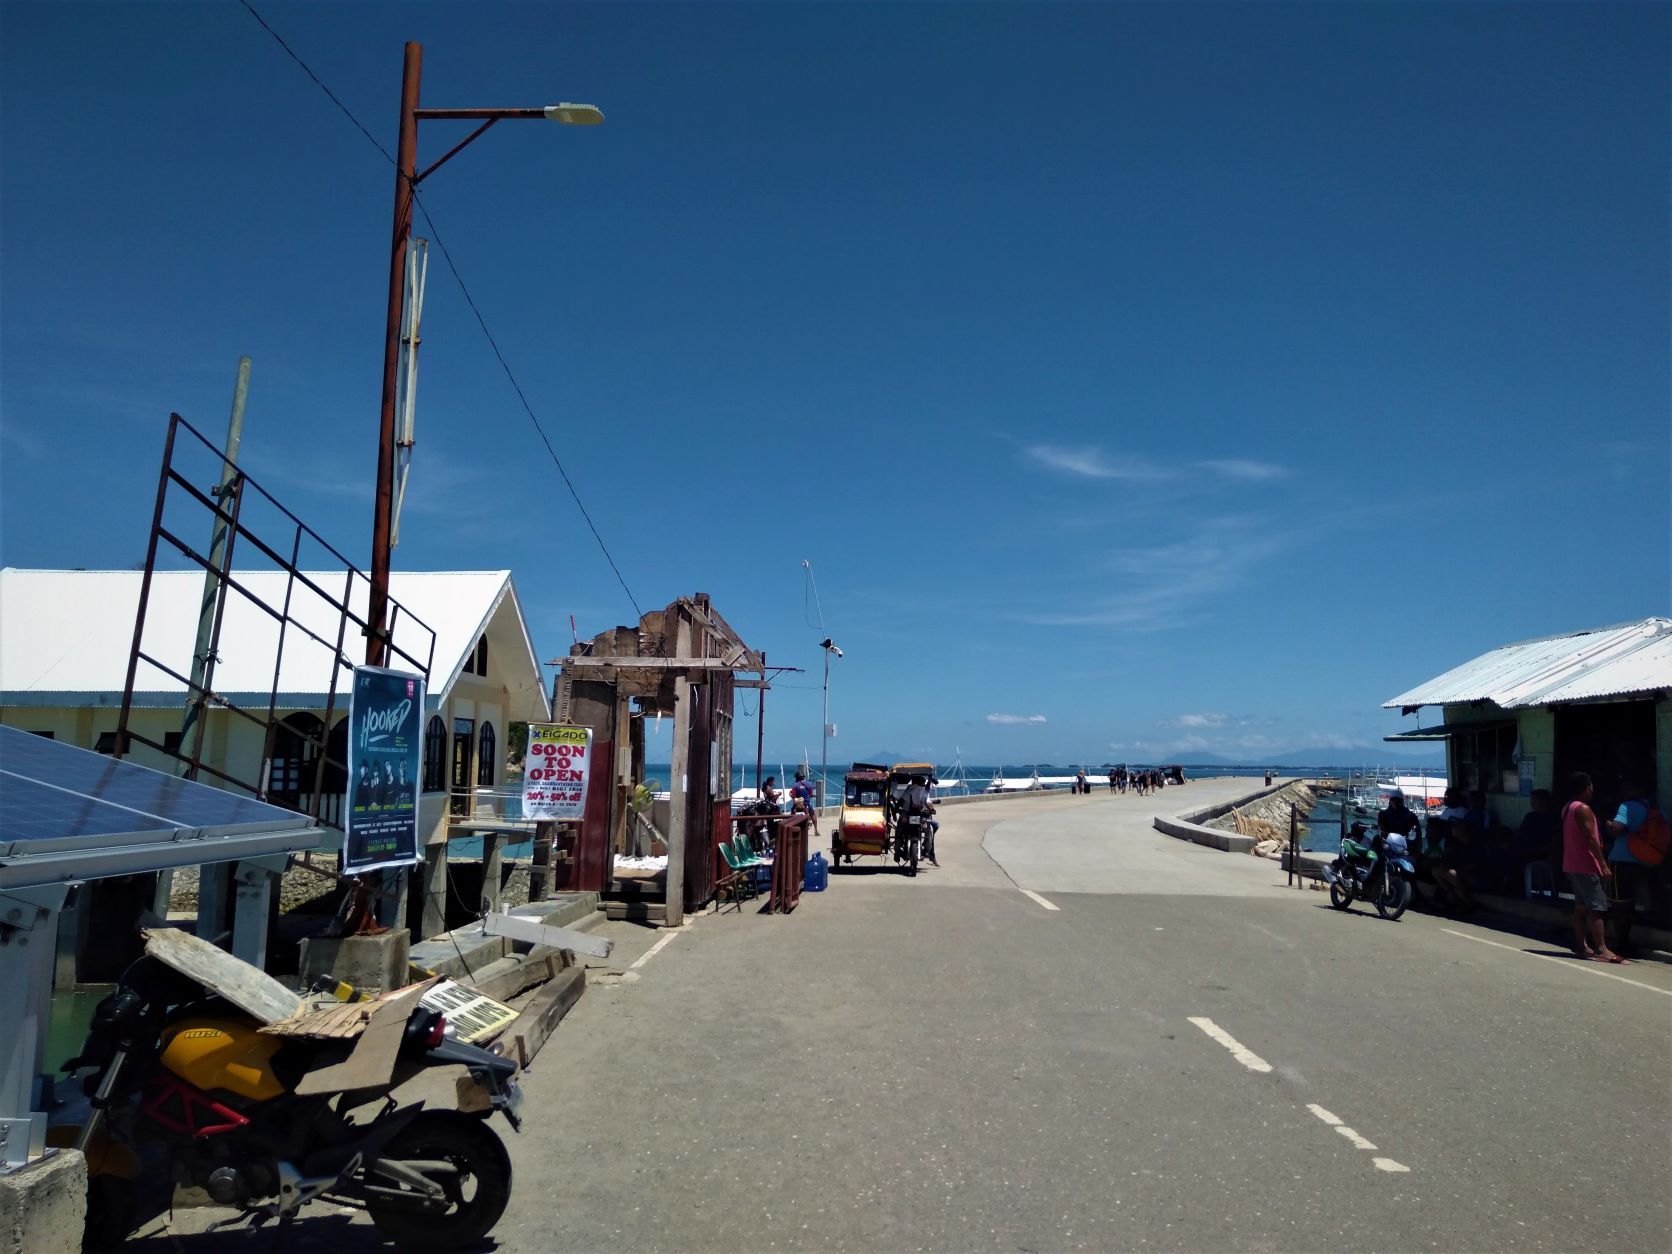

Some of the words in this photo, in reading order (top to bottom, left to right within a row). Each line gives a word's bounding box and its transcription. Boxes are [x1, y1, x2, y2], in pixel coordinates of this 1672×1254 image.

[360, 698, 412, 752] HOOKED
[531, 743, 585, 758] SOON
[544, 756, 571, 769] TO
[530, 768, 584, 781] OPEN
